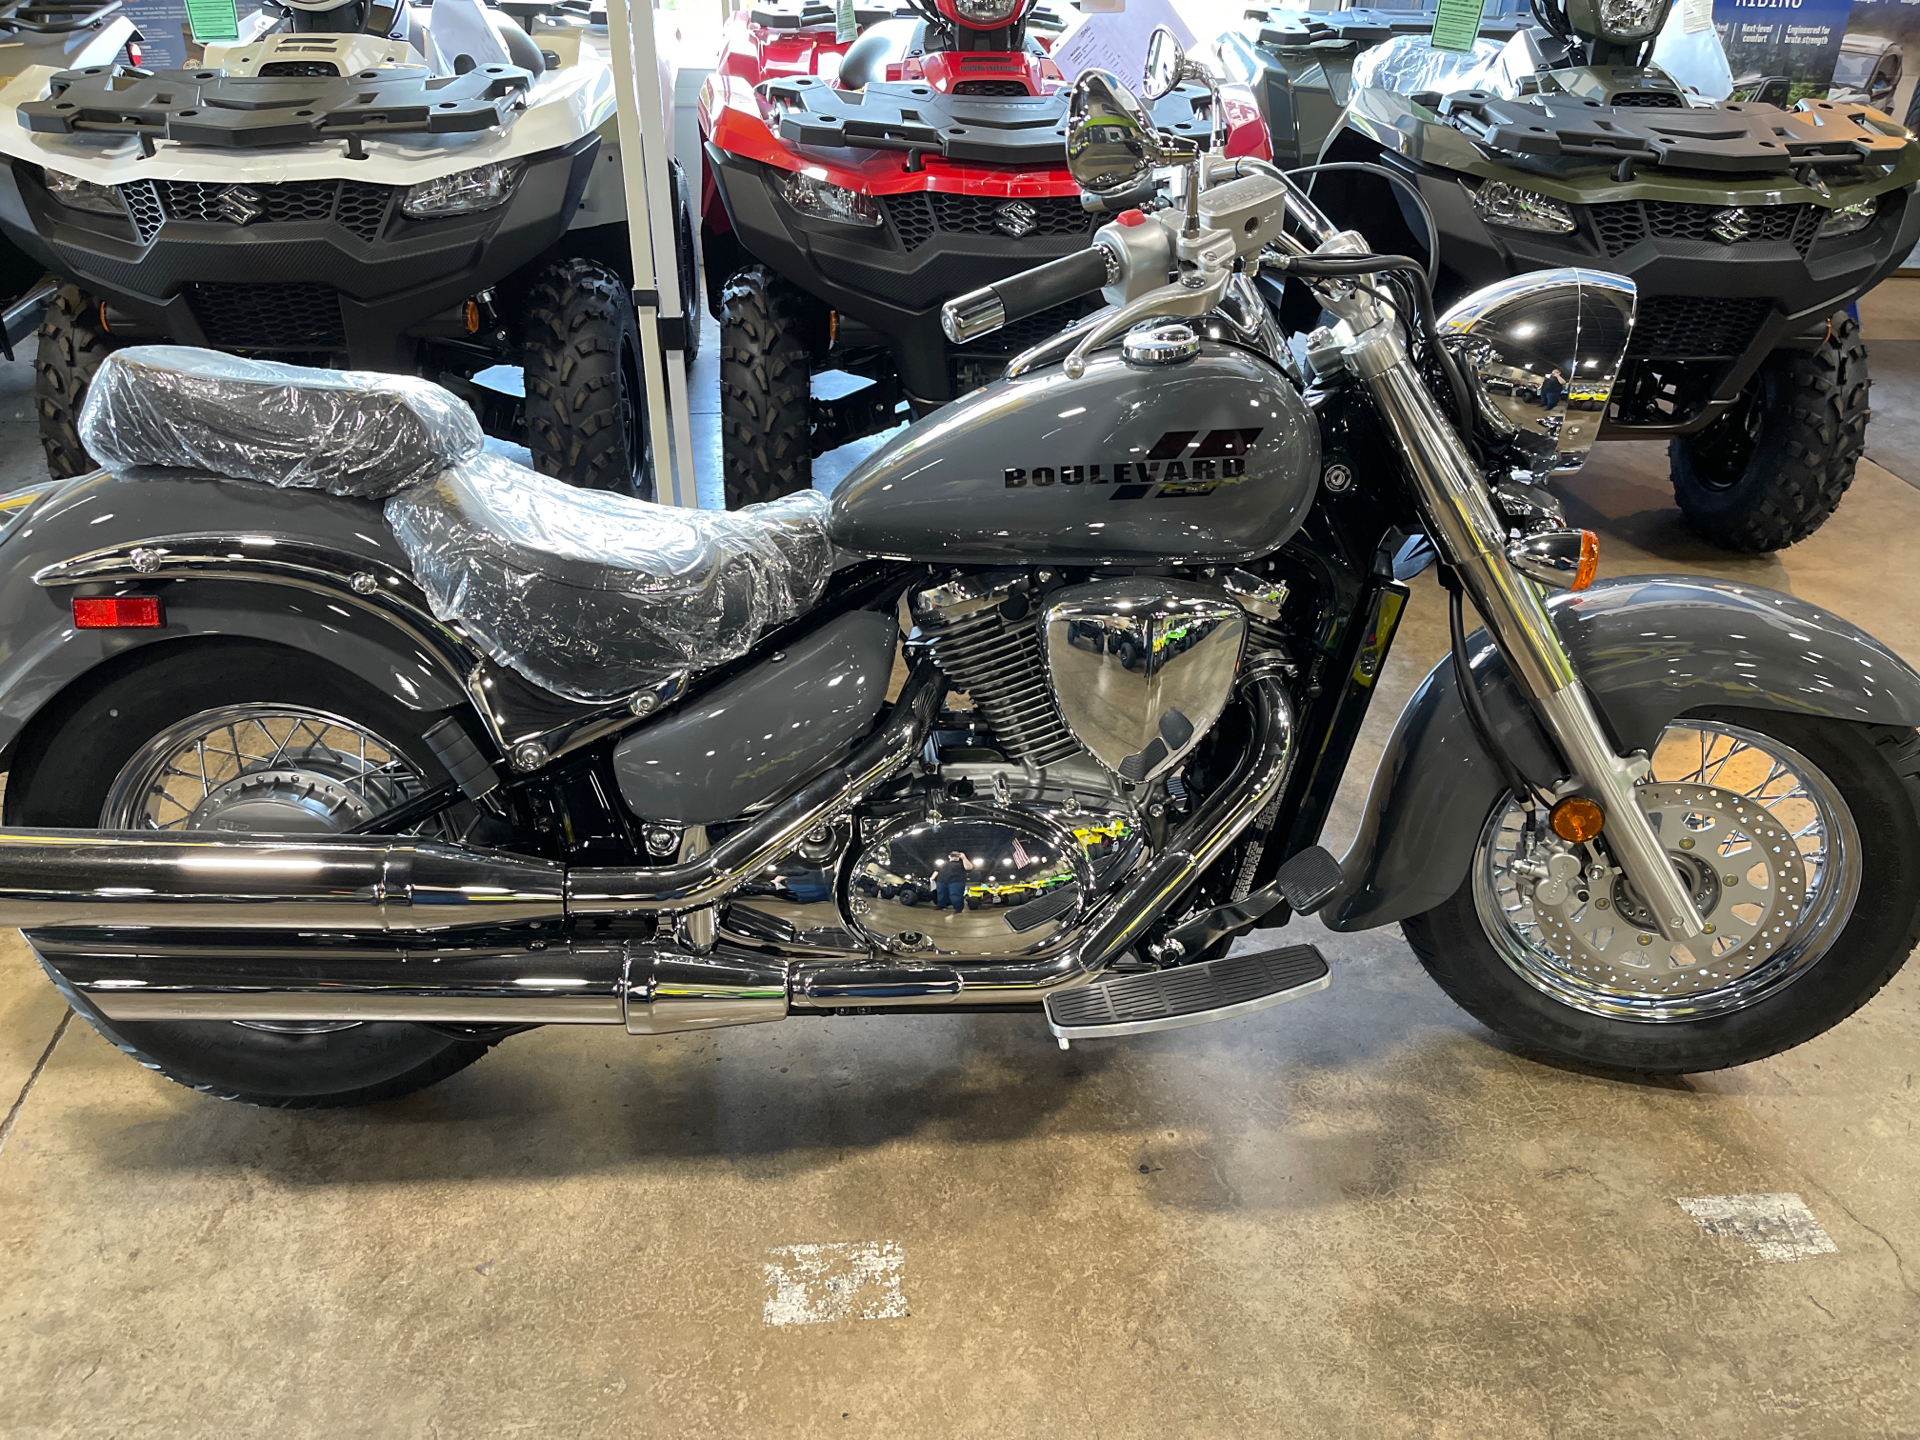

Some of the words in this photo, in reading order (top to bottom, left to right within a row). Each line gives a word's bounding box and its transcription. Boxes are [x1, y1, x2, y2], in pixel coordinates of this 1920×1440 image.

[1741, 23, 1774, 33] Next-level
[1787, 24, 1822, 36] Engineered
[1821, 25, 1831, 35] for
[1742, 33, 1768, 43] comfort
[1784, 34, 1802, 44] brute
[1801, 35, 1829, 47] strength
[1004, 457, 1247, 489] BOULEVARD
